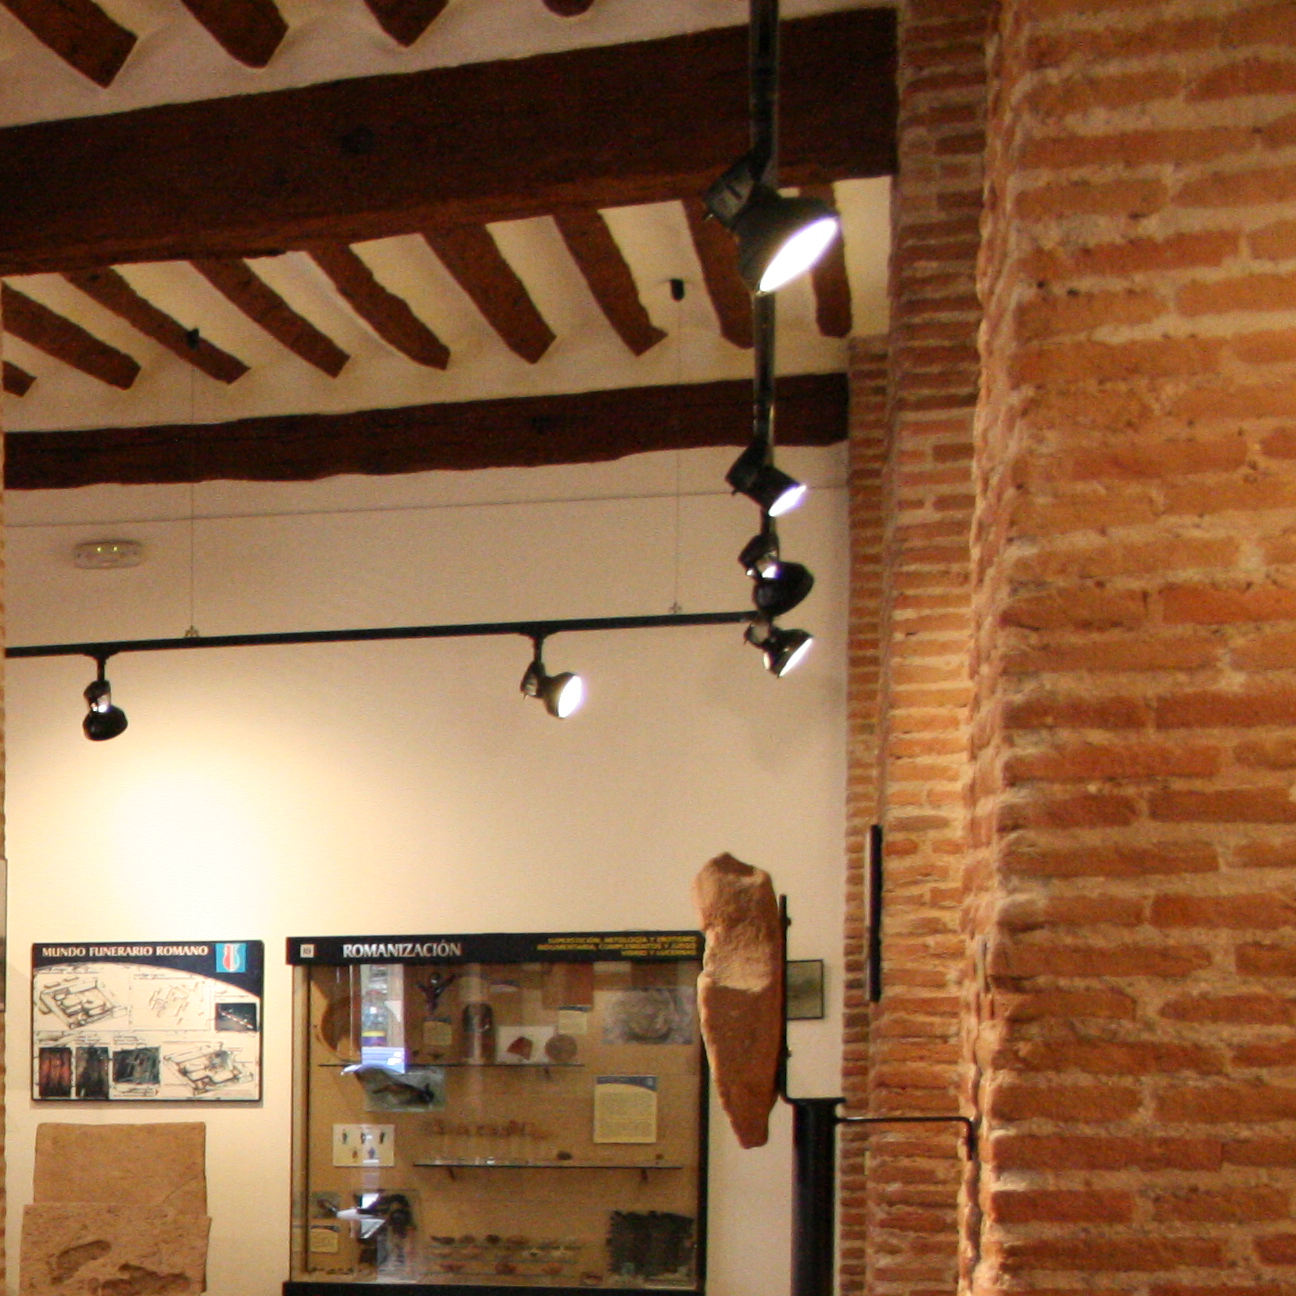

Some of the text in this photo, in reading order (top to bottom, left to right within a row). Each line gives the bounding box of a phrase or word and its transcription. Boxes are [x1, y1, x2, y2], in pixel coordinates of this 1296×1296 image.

[42, 945, 208, 957] MUNDO FUNERARIO ROMANO
[342, 939, 462, 958] ROMANIZACIÓN
